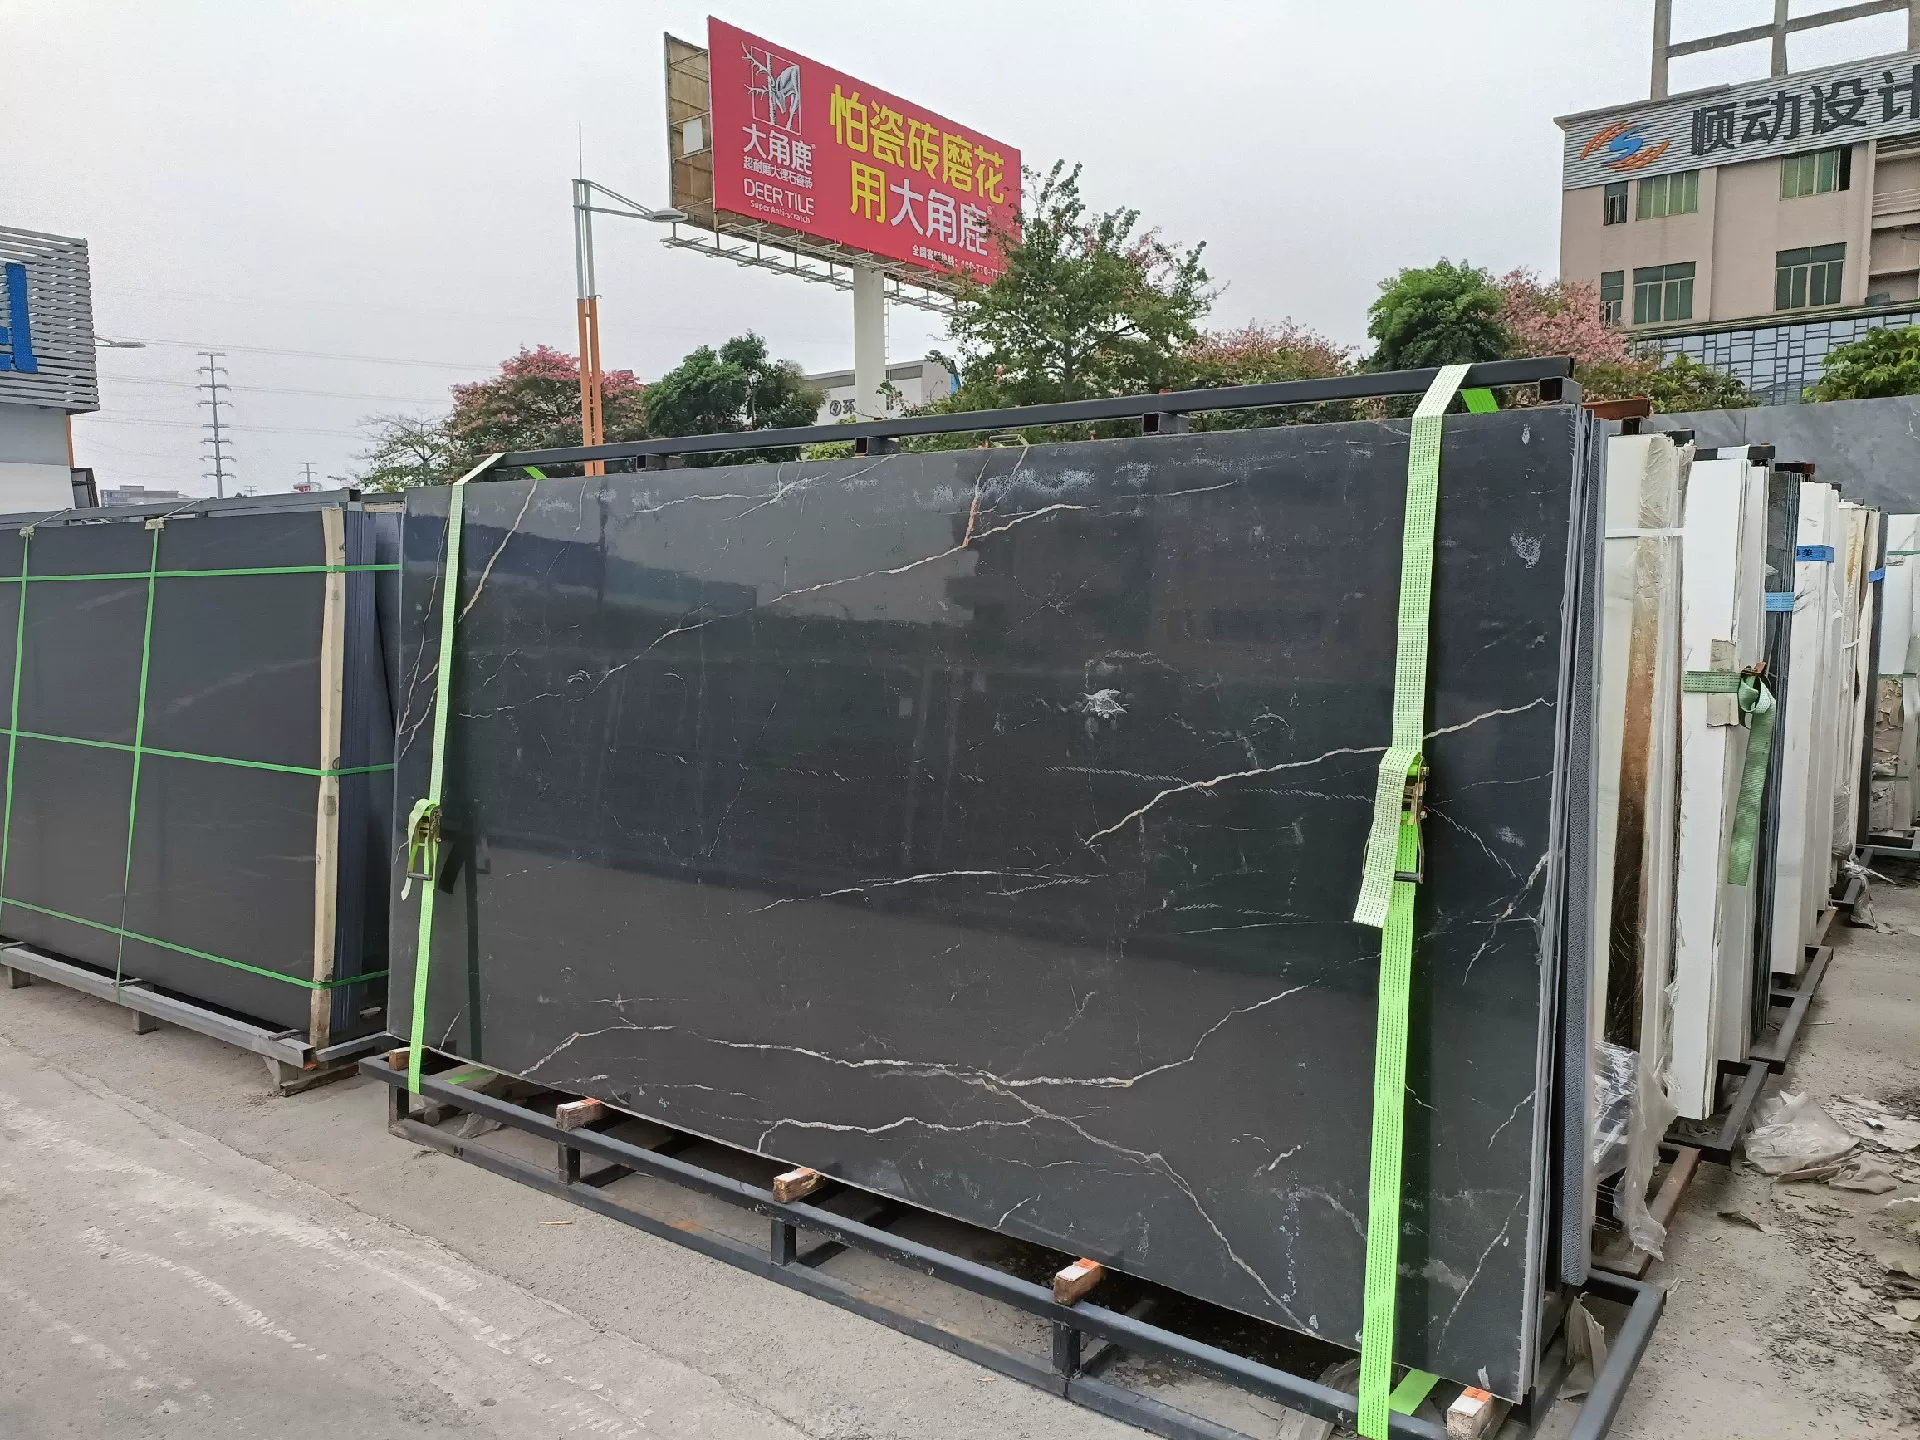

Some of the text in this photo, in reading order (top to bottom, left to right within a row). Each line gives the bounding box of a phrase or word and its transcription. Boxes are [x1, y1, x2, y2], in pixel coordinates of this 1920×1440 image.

[742, 123, 813, 175] 大角鹿
[830, 83, 1004, 204] 怕瓷砖磨花
[744, 177, 815, 216] DEER TILE
[850, 159, 988, 256] 用大角鹿
